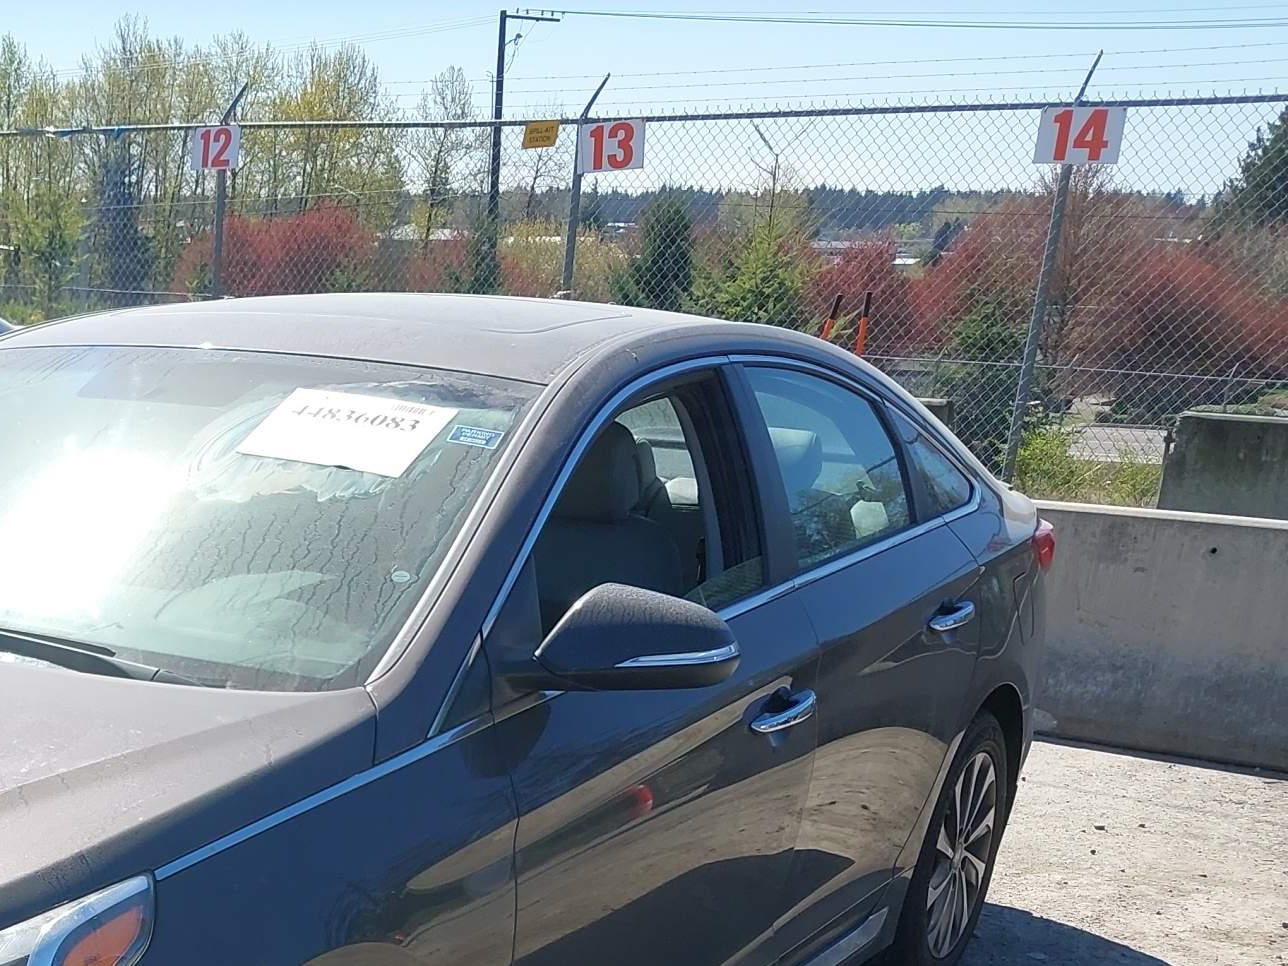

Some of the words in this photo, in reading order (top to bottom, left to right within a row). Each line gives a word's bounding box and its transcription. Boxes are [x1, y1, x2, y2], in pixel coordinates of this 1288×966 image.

[200, 127, 232, 168] 12
[590, 122, 635, 170] 13
[1053, 108, 1109, 161] 14
